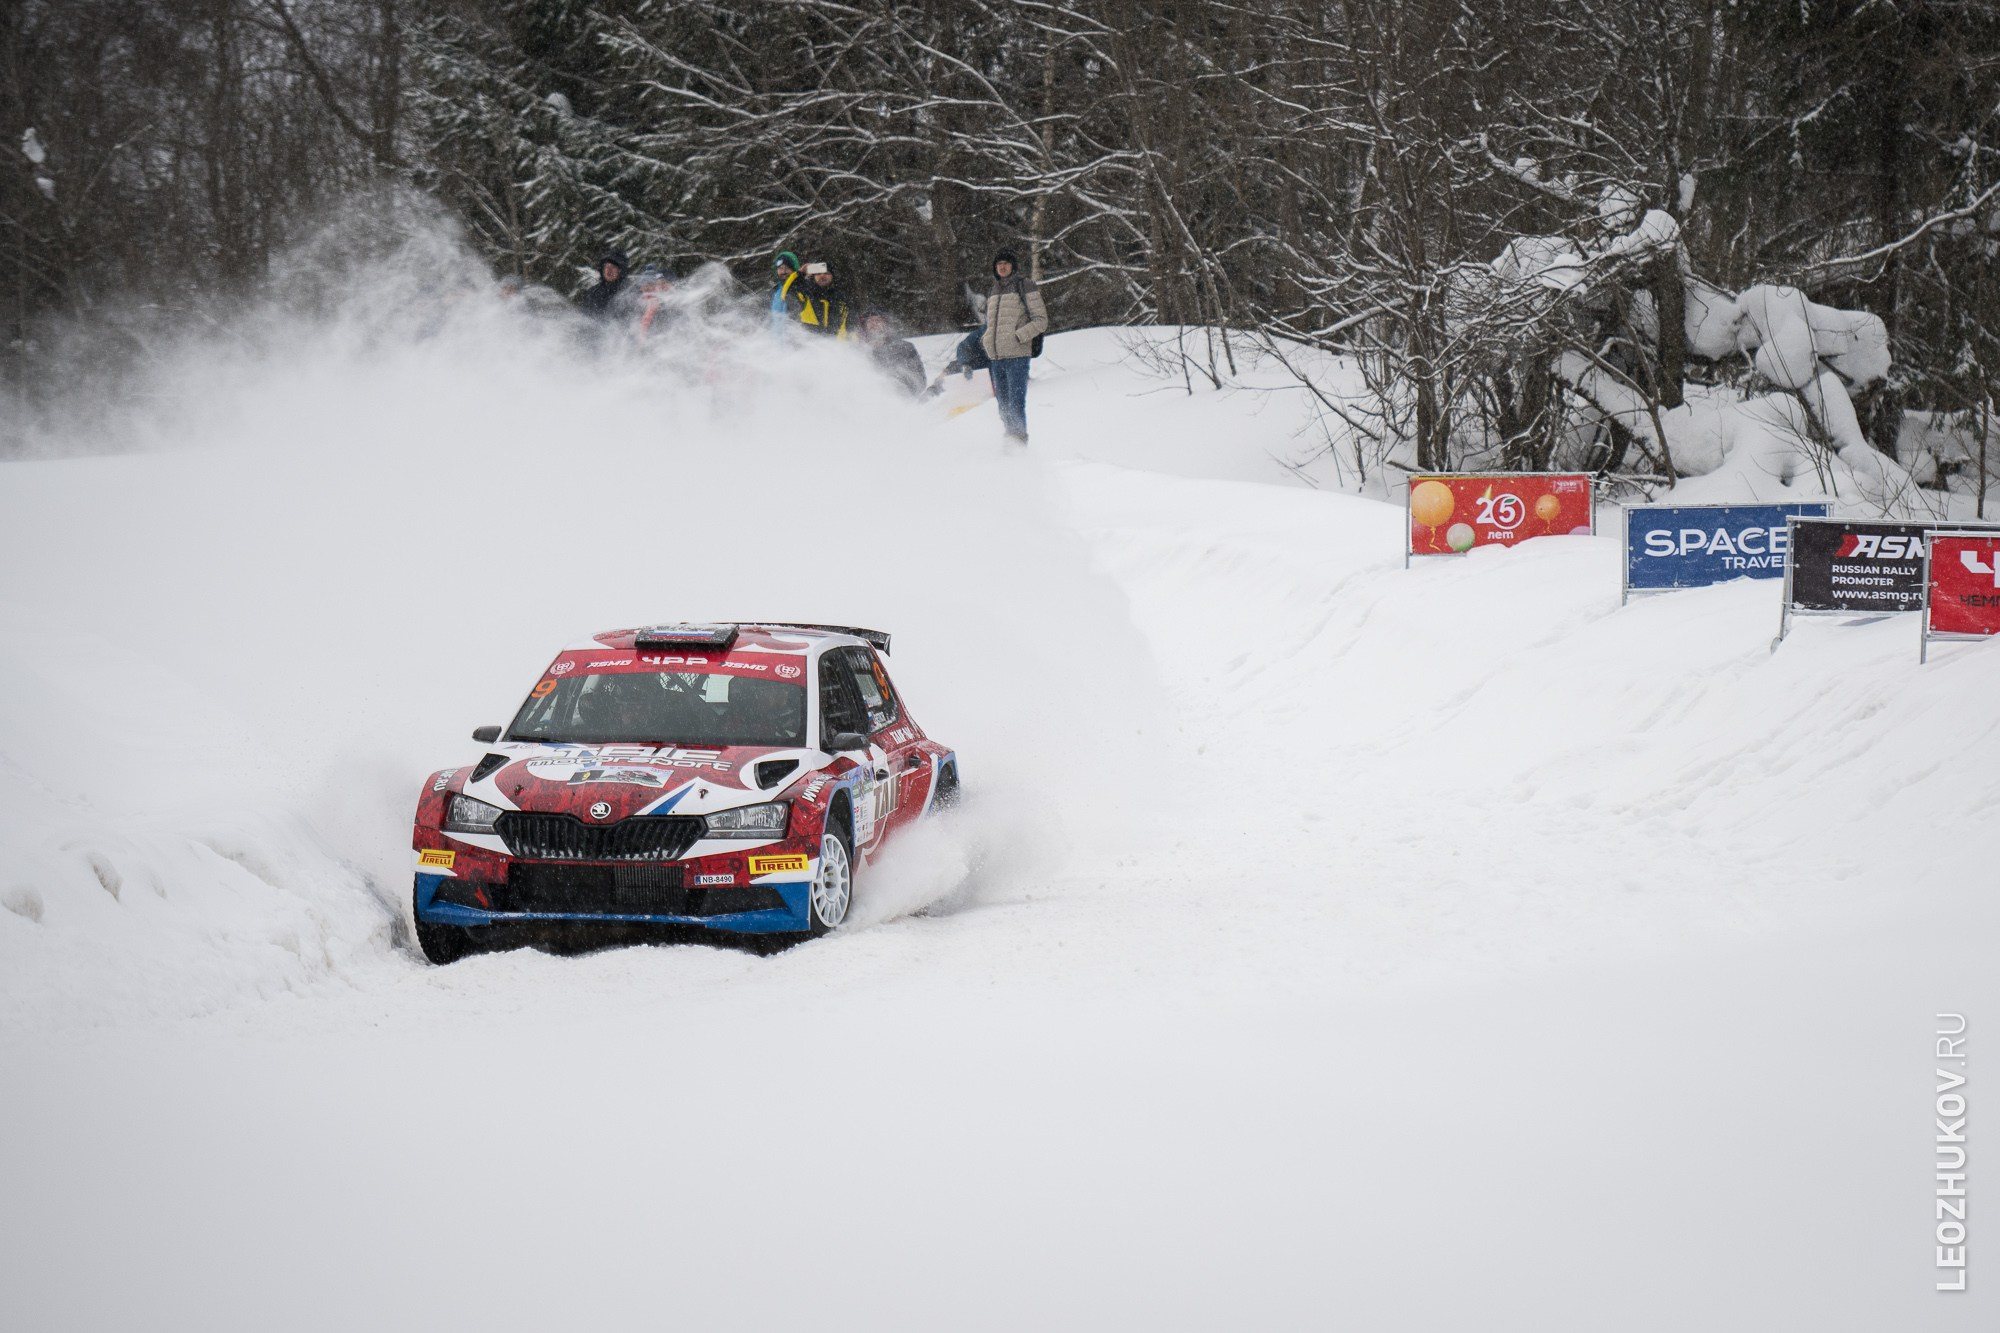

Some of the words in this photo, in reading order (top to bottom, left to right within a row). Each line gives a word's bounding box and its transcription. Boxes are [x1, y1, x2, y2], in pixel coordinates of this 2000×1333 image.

[1487, 531, 1514, 540] лет
[1645, 527, 1788, 557] SPACE
[1722, 556, 1787, 569] TRAVE
[1832, 565, 1880, 575] RUSSIAN
[1883, 566, 1917, 575] RALLY
[1832, 576, 1894, 586] PROMOTER
[872, 661, 889, 700] 9
[531, 679, 558, 698] 9
[422, 853, 452, 865] PIRELLI
[755, 857, 803, 871] PIRELLI
[702, 875, 732, 884] NB-8490
